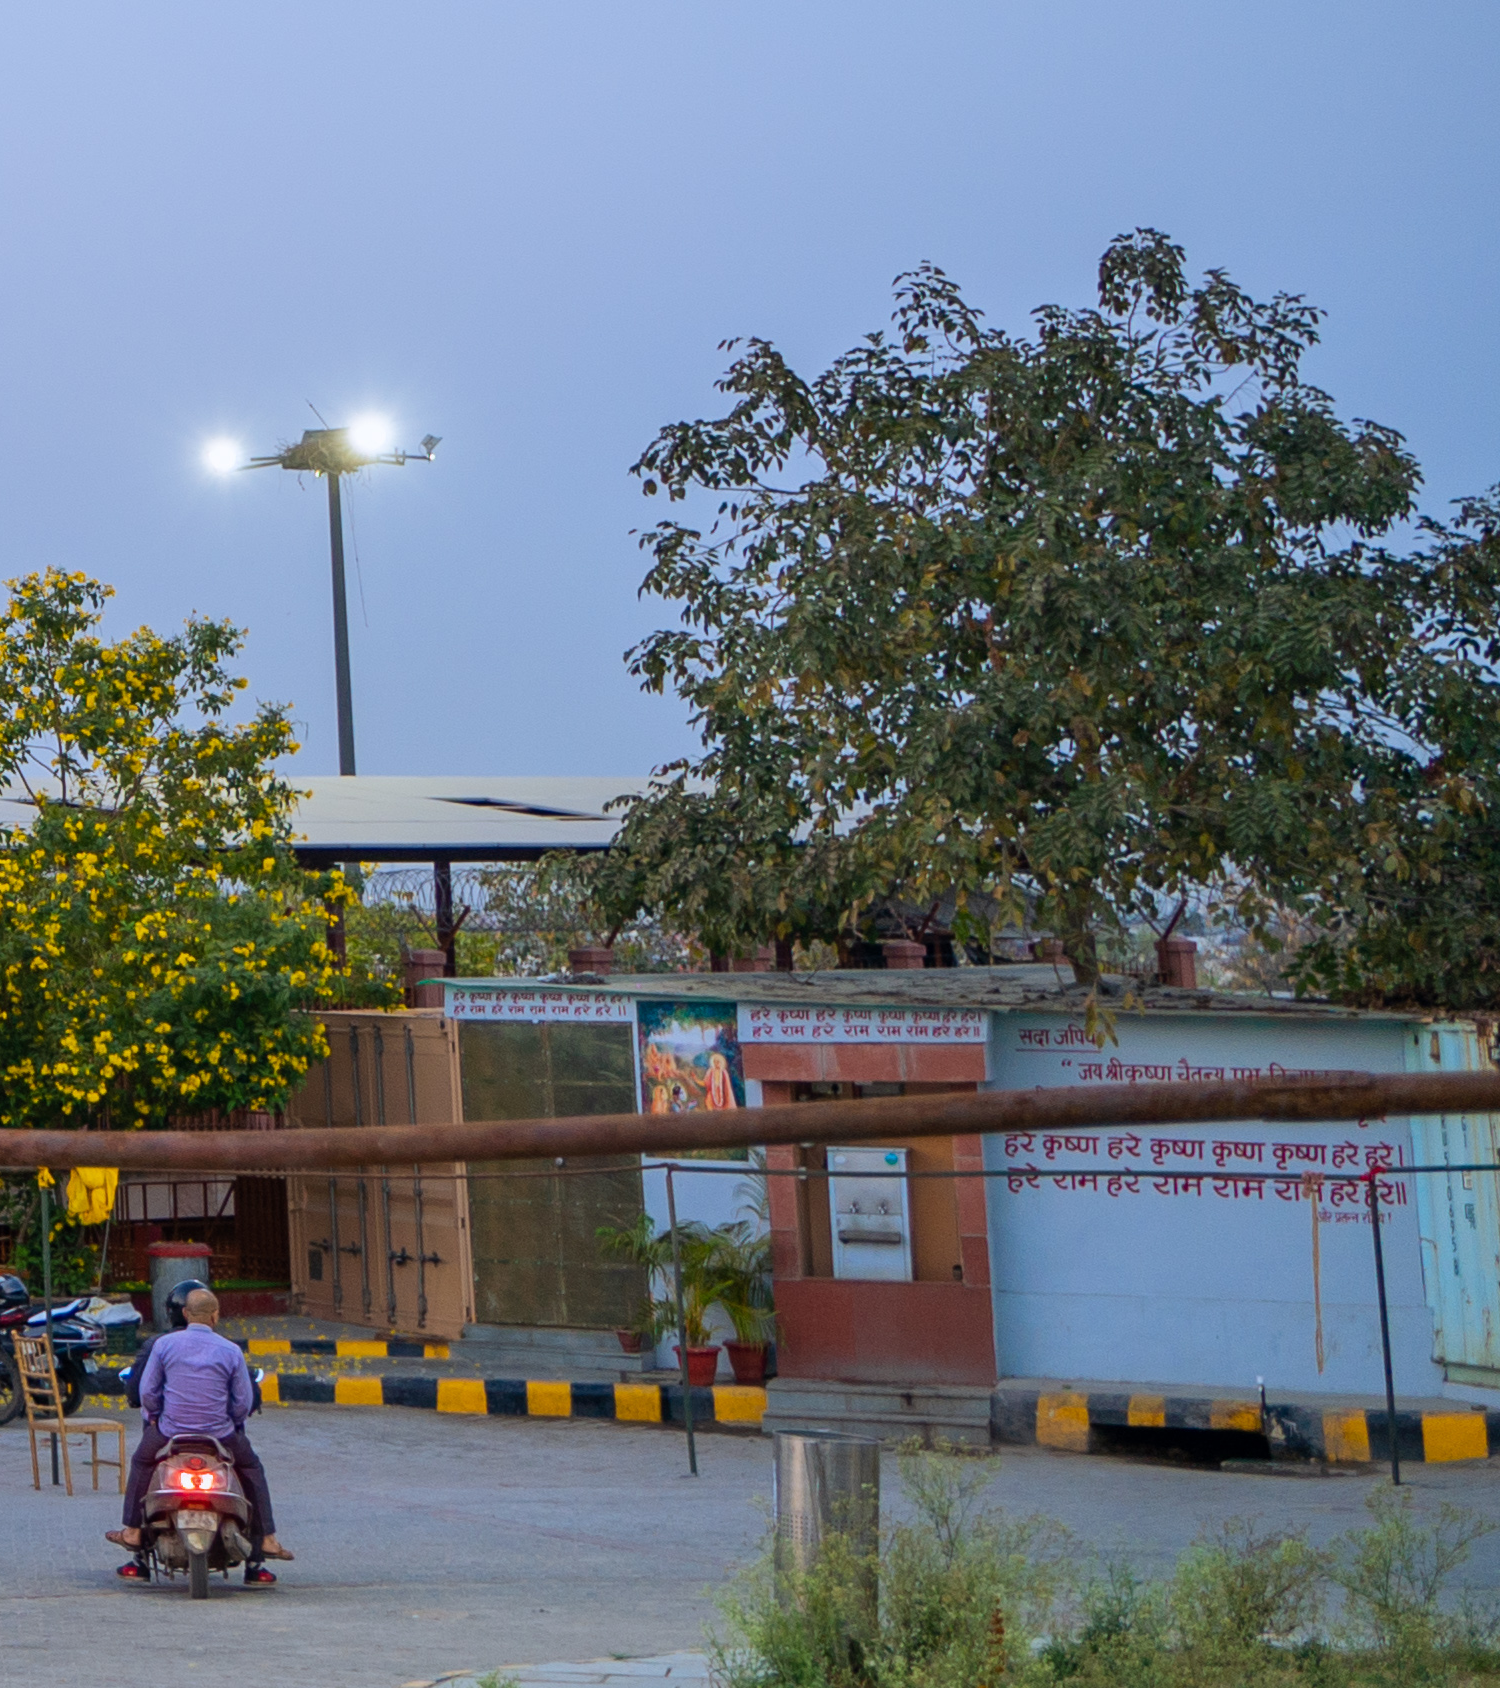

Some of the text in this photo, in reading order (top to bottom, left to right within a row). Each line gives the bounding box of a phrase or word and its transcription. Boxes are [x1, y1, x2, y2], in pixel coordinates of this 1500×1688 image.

[453, 989, 622, 1005] हरे कृष्ण हरे कृष्ण कृष्ण कृष्ण हरे हरे
[453, 1003, 611, 1017] हरे राम हरे राम राम राम हरे हरे
[750, 1006, 770, 1021] हरे
[776, 1008, 810, 1023] कृष्ण
[815, 1007, 836, 1021] हरे
[841, 1009, 872, 1023] कृष्ण
[877, 1009, 905, 1023] कृष्ण
[911, 1009, 940, 1023] कृष्ण
[941, 1008, 957, 1022] हरे
[752, 1023, 773, 1038] हरे
[781, 1025, 804, 1037] राम
[812, 1023, 835, 1038] हरे
[844, 1025, 869, 1037] राम
[877, 1025, 901, 1037] राम
[906, 1025, 928, 1037] राम
[932, 1023, 950, 1037] हरे
[1018, 1028, 1049, 1046] सदा
[1078, 1062, 1102, 1080] जय
[1005, 1131, 1036, 1157] हरे
[1043, 1134, 1099, 1160] कृष्ण
[1107, 1133, 1141, 1159] हरे
[1150, 1138, 1204, 1165] कृष्ण
[1212, 1139, 1264, 1166] कृष्ण
[1273, 1142, 1326, 1169] कृष्ण
[1332, 1141, 1359, 1168] हरे
[1007, 1164, 1040, 1193] हरे
[1053, 1173, 1098, 1191] राम
[1107, 1168, 1140, 1196] हरे
[1153, 1176, 1202, 1196] राम
[1213, 1178, 1263, 1200] राम
[1330, 1179, 1359, 1207] हरे
